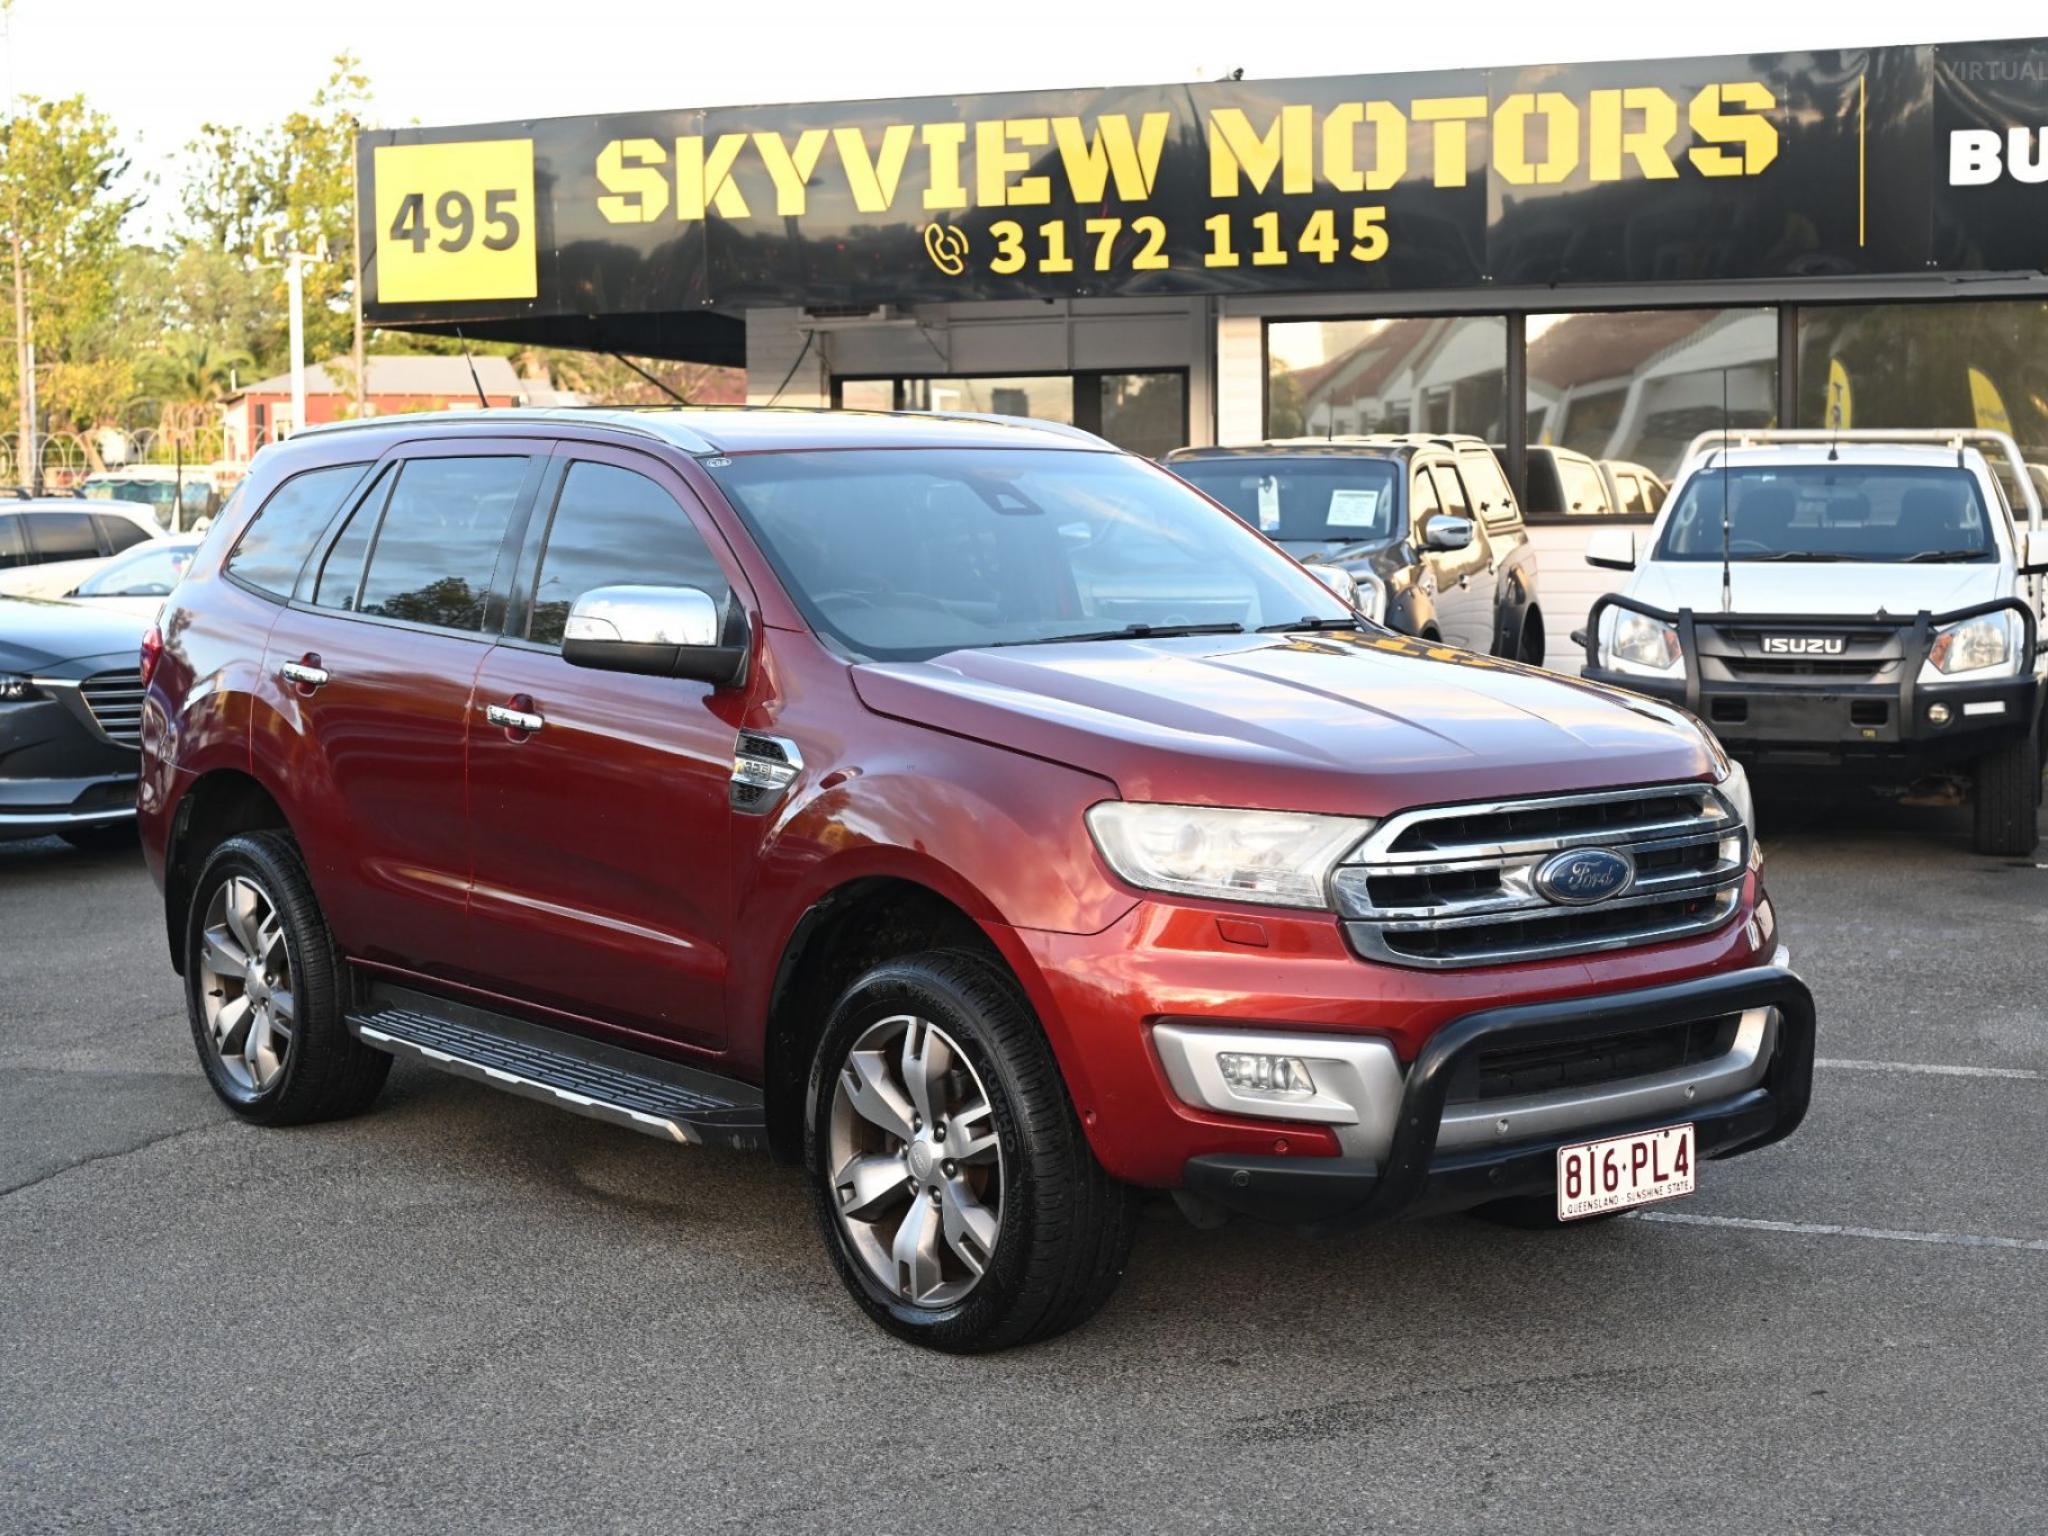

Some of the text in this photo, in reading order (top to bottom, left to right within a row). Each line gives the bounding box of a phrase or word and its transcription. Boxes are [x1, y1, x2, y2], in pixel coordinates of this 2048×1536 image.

[596, 81, 1779, 224] SKYVIEW MOTORS
[389, 188, 521, 254] 495
[988, 206, 1390, 275] 3172 1145
[1763, 637, 1843, 655] ISUZU
[1568, 860, 1614, 890] Ford
[1566, 1180, 1689, 1215] QUEENSLAND SUNSHINE STATE
